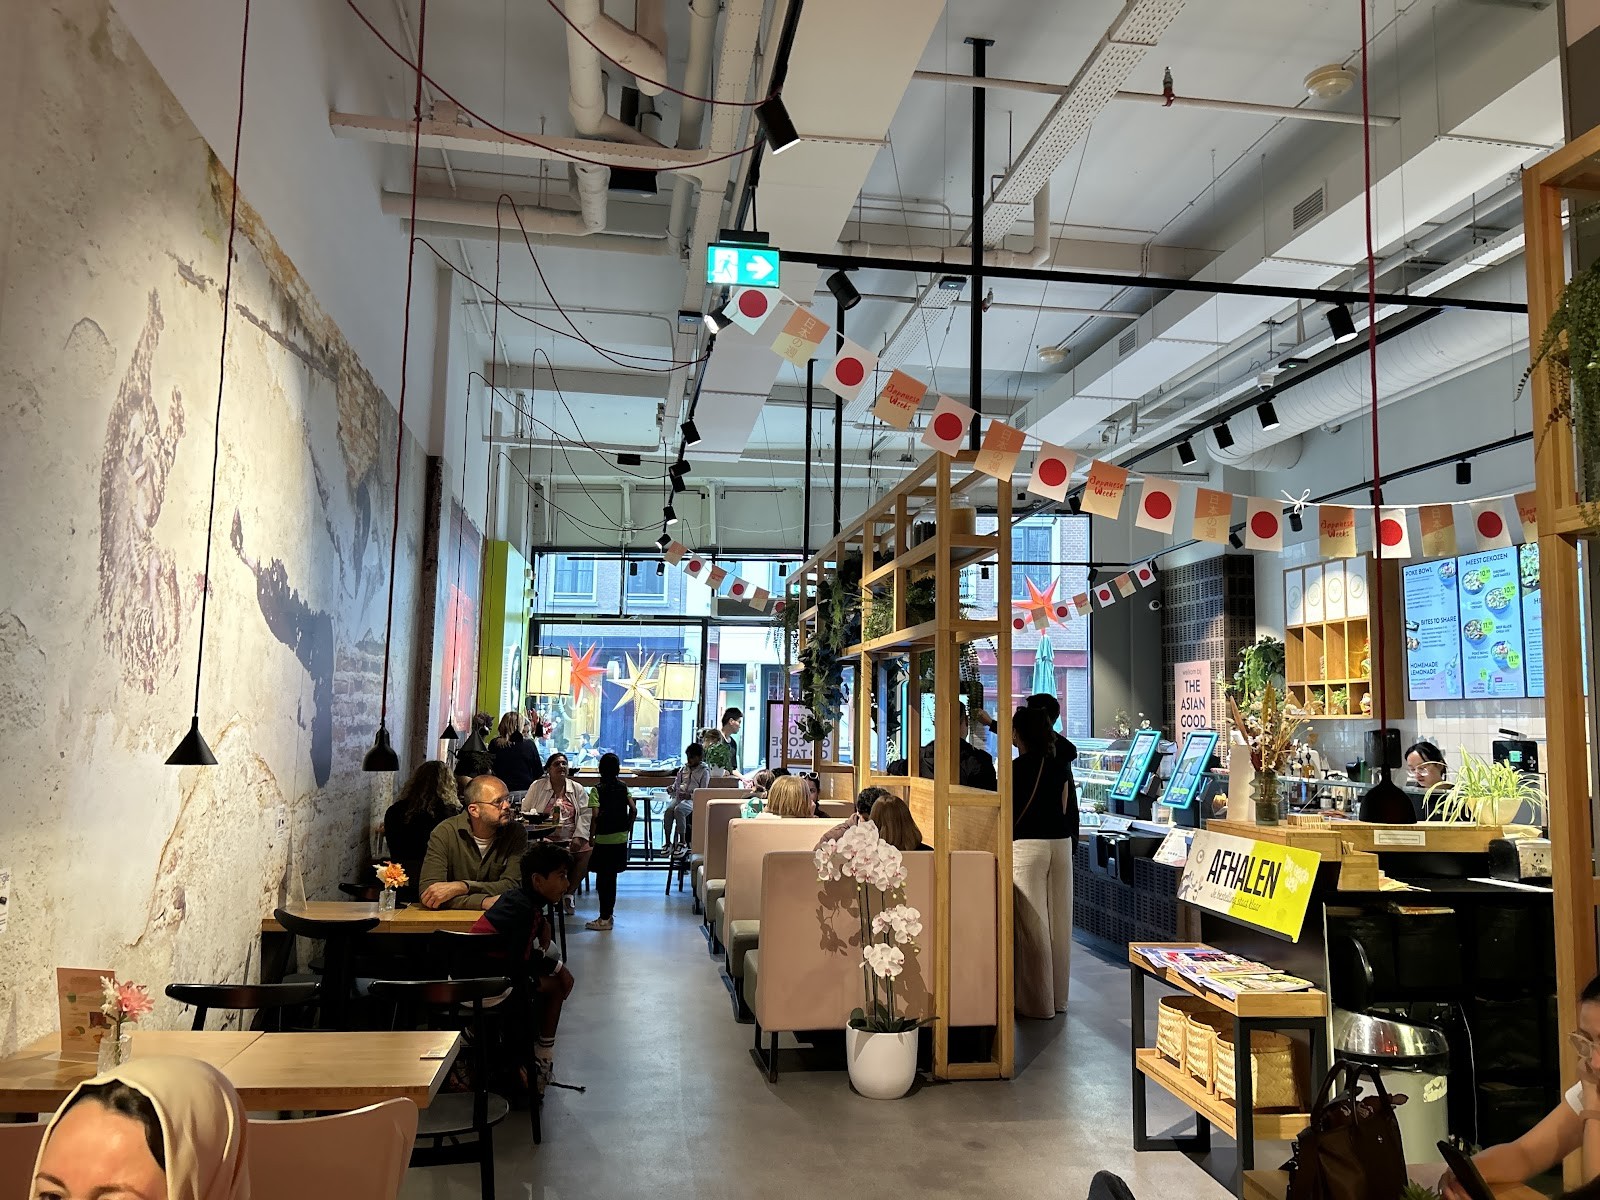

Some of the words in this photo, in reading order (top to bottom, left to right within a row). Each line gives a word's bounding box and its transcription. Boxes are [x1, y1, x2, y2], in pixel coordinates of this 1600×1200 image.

[887, 383, 920, 403] Japanese
[889, 395, 911, 411] Weeks
[1089, 475, 1124, 490] Japanese
[1094, 486, 1117, 498] Weeks
[1520, 507, 1536, 517] Japa
[1320, 519, 1354, 530] Japanese
[1327, 529, 1350, 538] Weeks
[1465, 557, 1482, 566] MEEST
[1482, 552, 1508, 563] GEKOZEN
[1405, 569, 1418, 577] POKE
[1418, 566, 1433, 575] BOWL
[1420, 618, 1434, 626] BITES
[1440, 615, 1457, 623] SHARE
[1410, 668, 1437, 676] LEMONADE
[1184, 680, 1201, 693] THE
[1180, 697, 1206, 711] ASIAN
[1180, 714, 1206, 728] GOOD
[1206, 848, 1282, 900] AFHALEN
